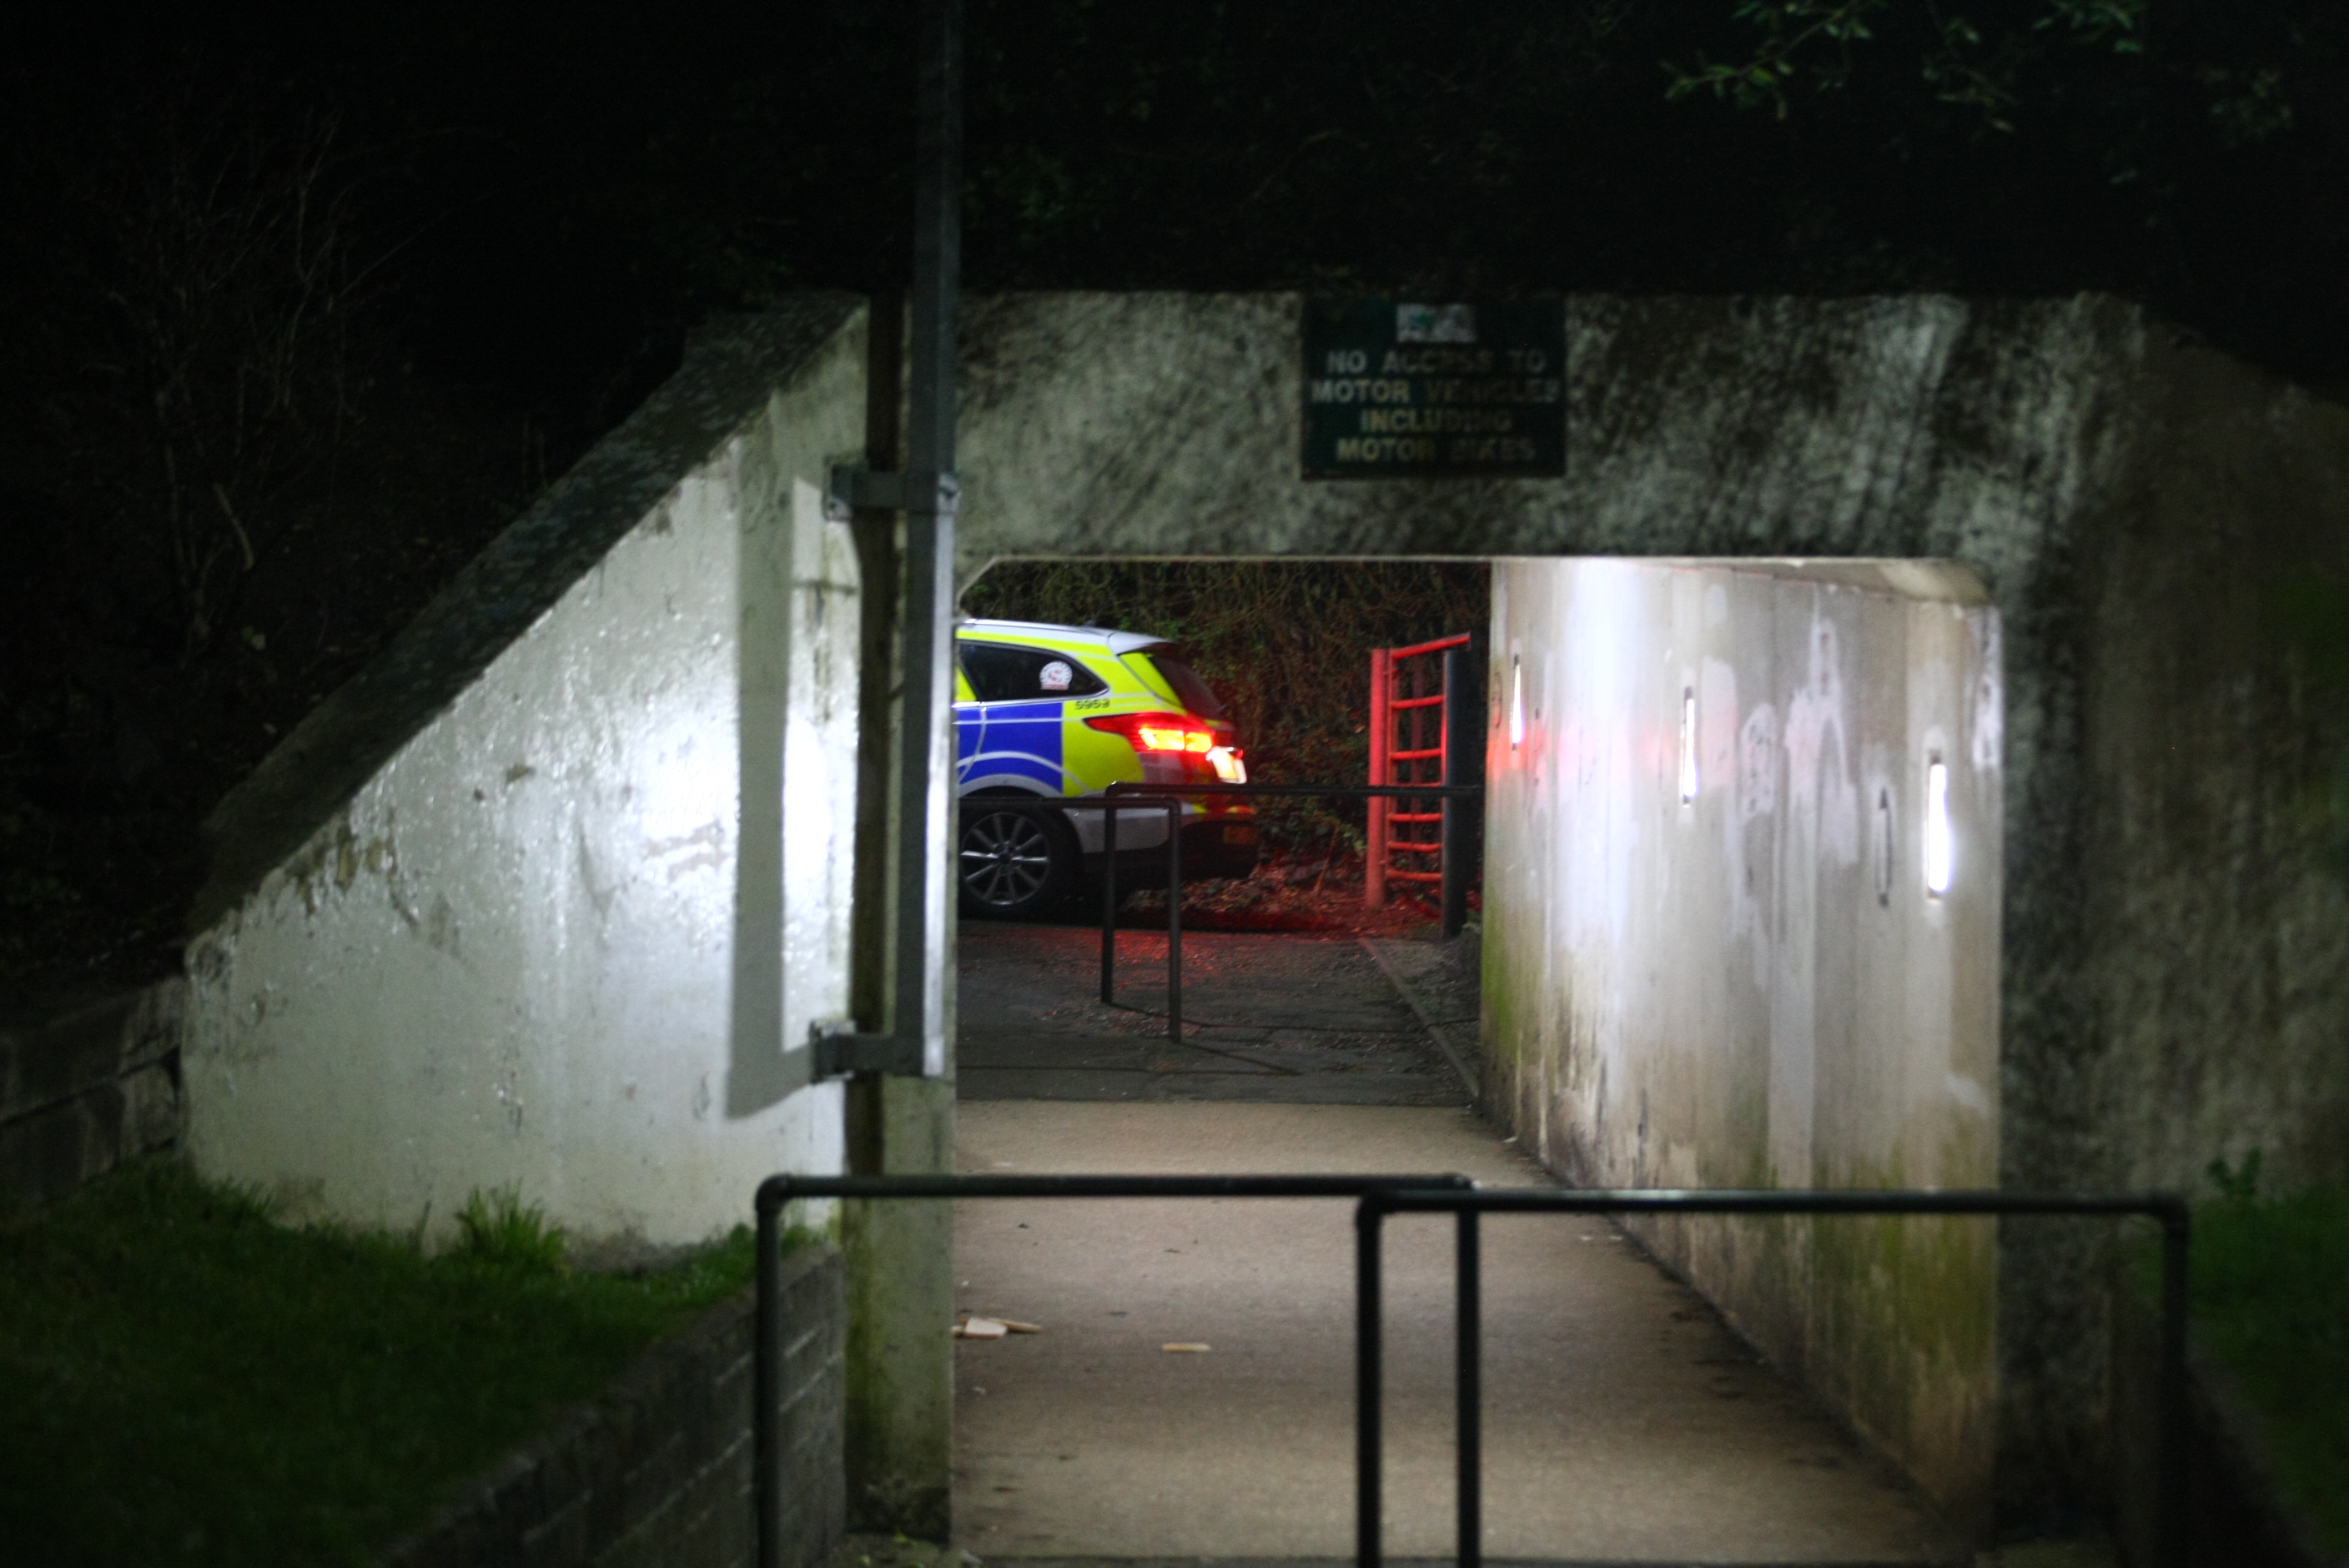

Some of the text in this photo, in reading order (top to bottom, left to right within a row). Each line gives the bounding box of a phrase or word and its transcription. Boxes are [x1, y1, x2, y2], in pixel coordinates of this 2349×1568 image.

[1325, 348, 1547, 374] NO ACCESS TO
[1310, 378, 1411, 404] MOTOR
[1335, 437, 1436, 461] MOTOR
